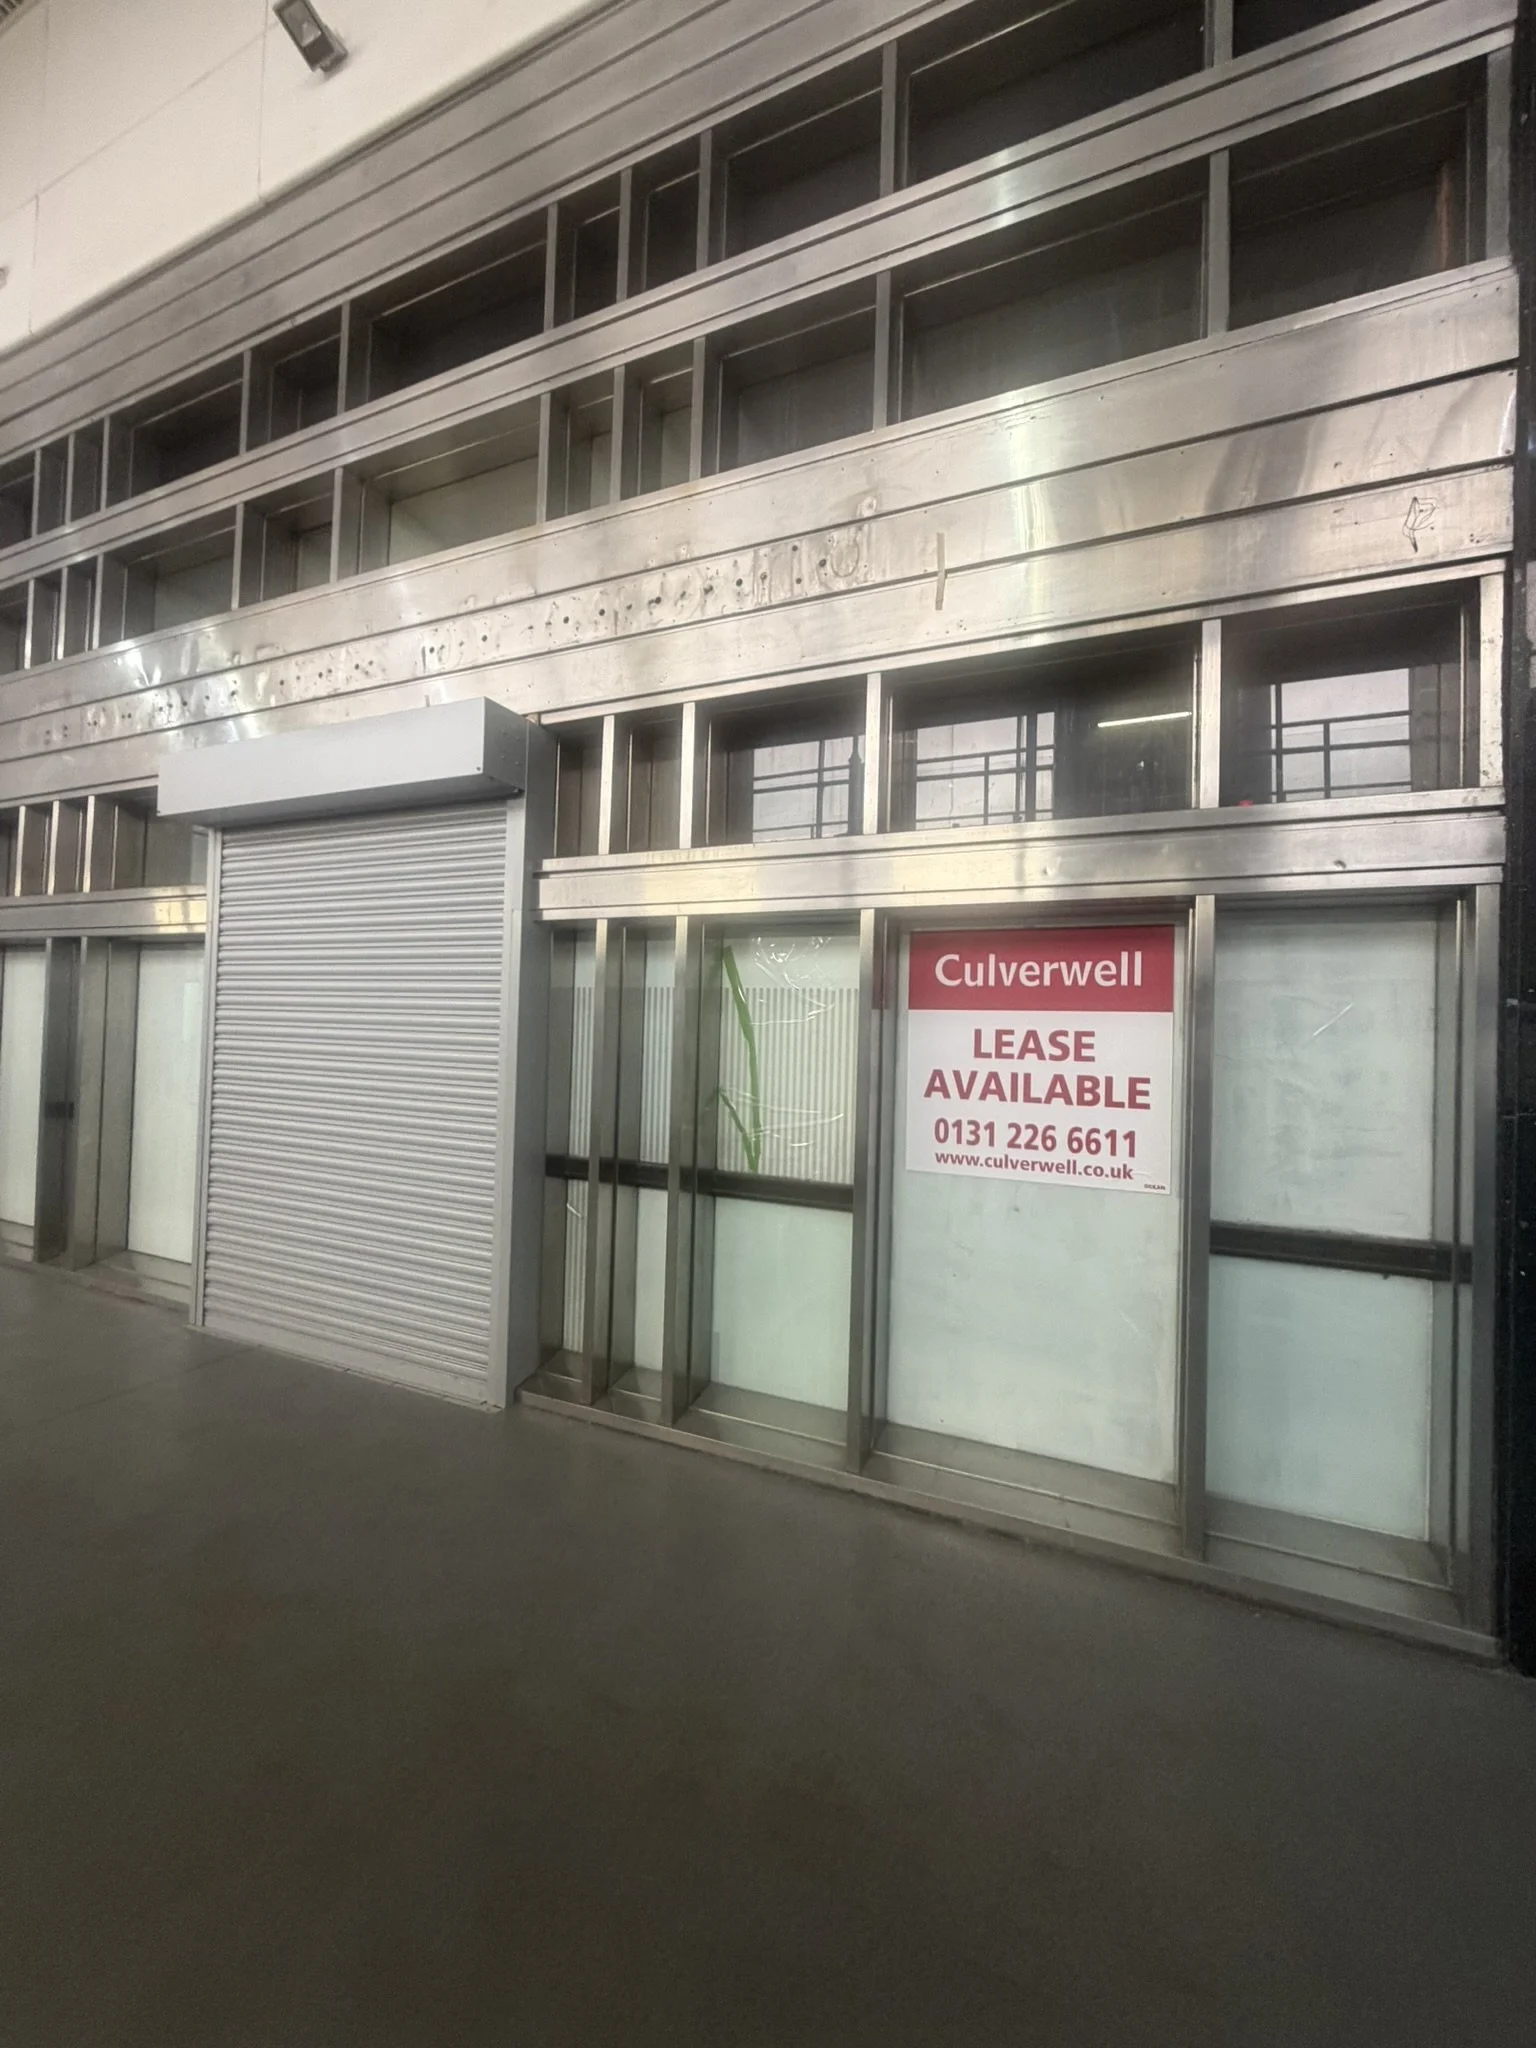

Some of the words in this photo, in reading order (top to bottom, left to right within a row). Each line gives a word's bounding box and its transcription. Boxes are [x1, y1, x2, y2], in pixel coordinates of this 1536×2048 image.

[934, 950, 1143, 987] Culverwell
[973, 1028, 1096, 1062] LEASE
[923, 1068, 1151, 1110] AVAILABLE
[934, 1117, 996, 1147] 0131
[1007, 1122, 1057, 1152] 226
[1067, 1126, 1136, 1158] 6611
[934, 1151, 1134, 1180] www.culverwell.co.uk
